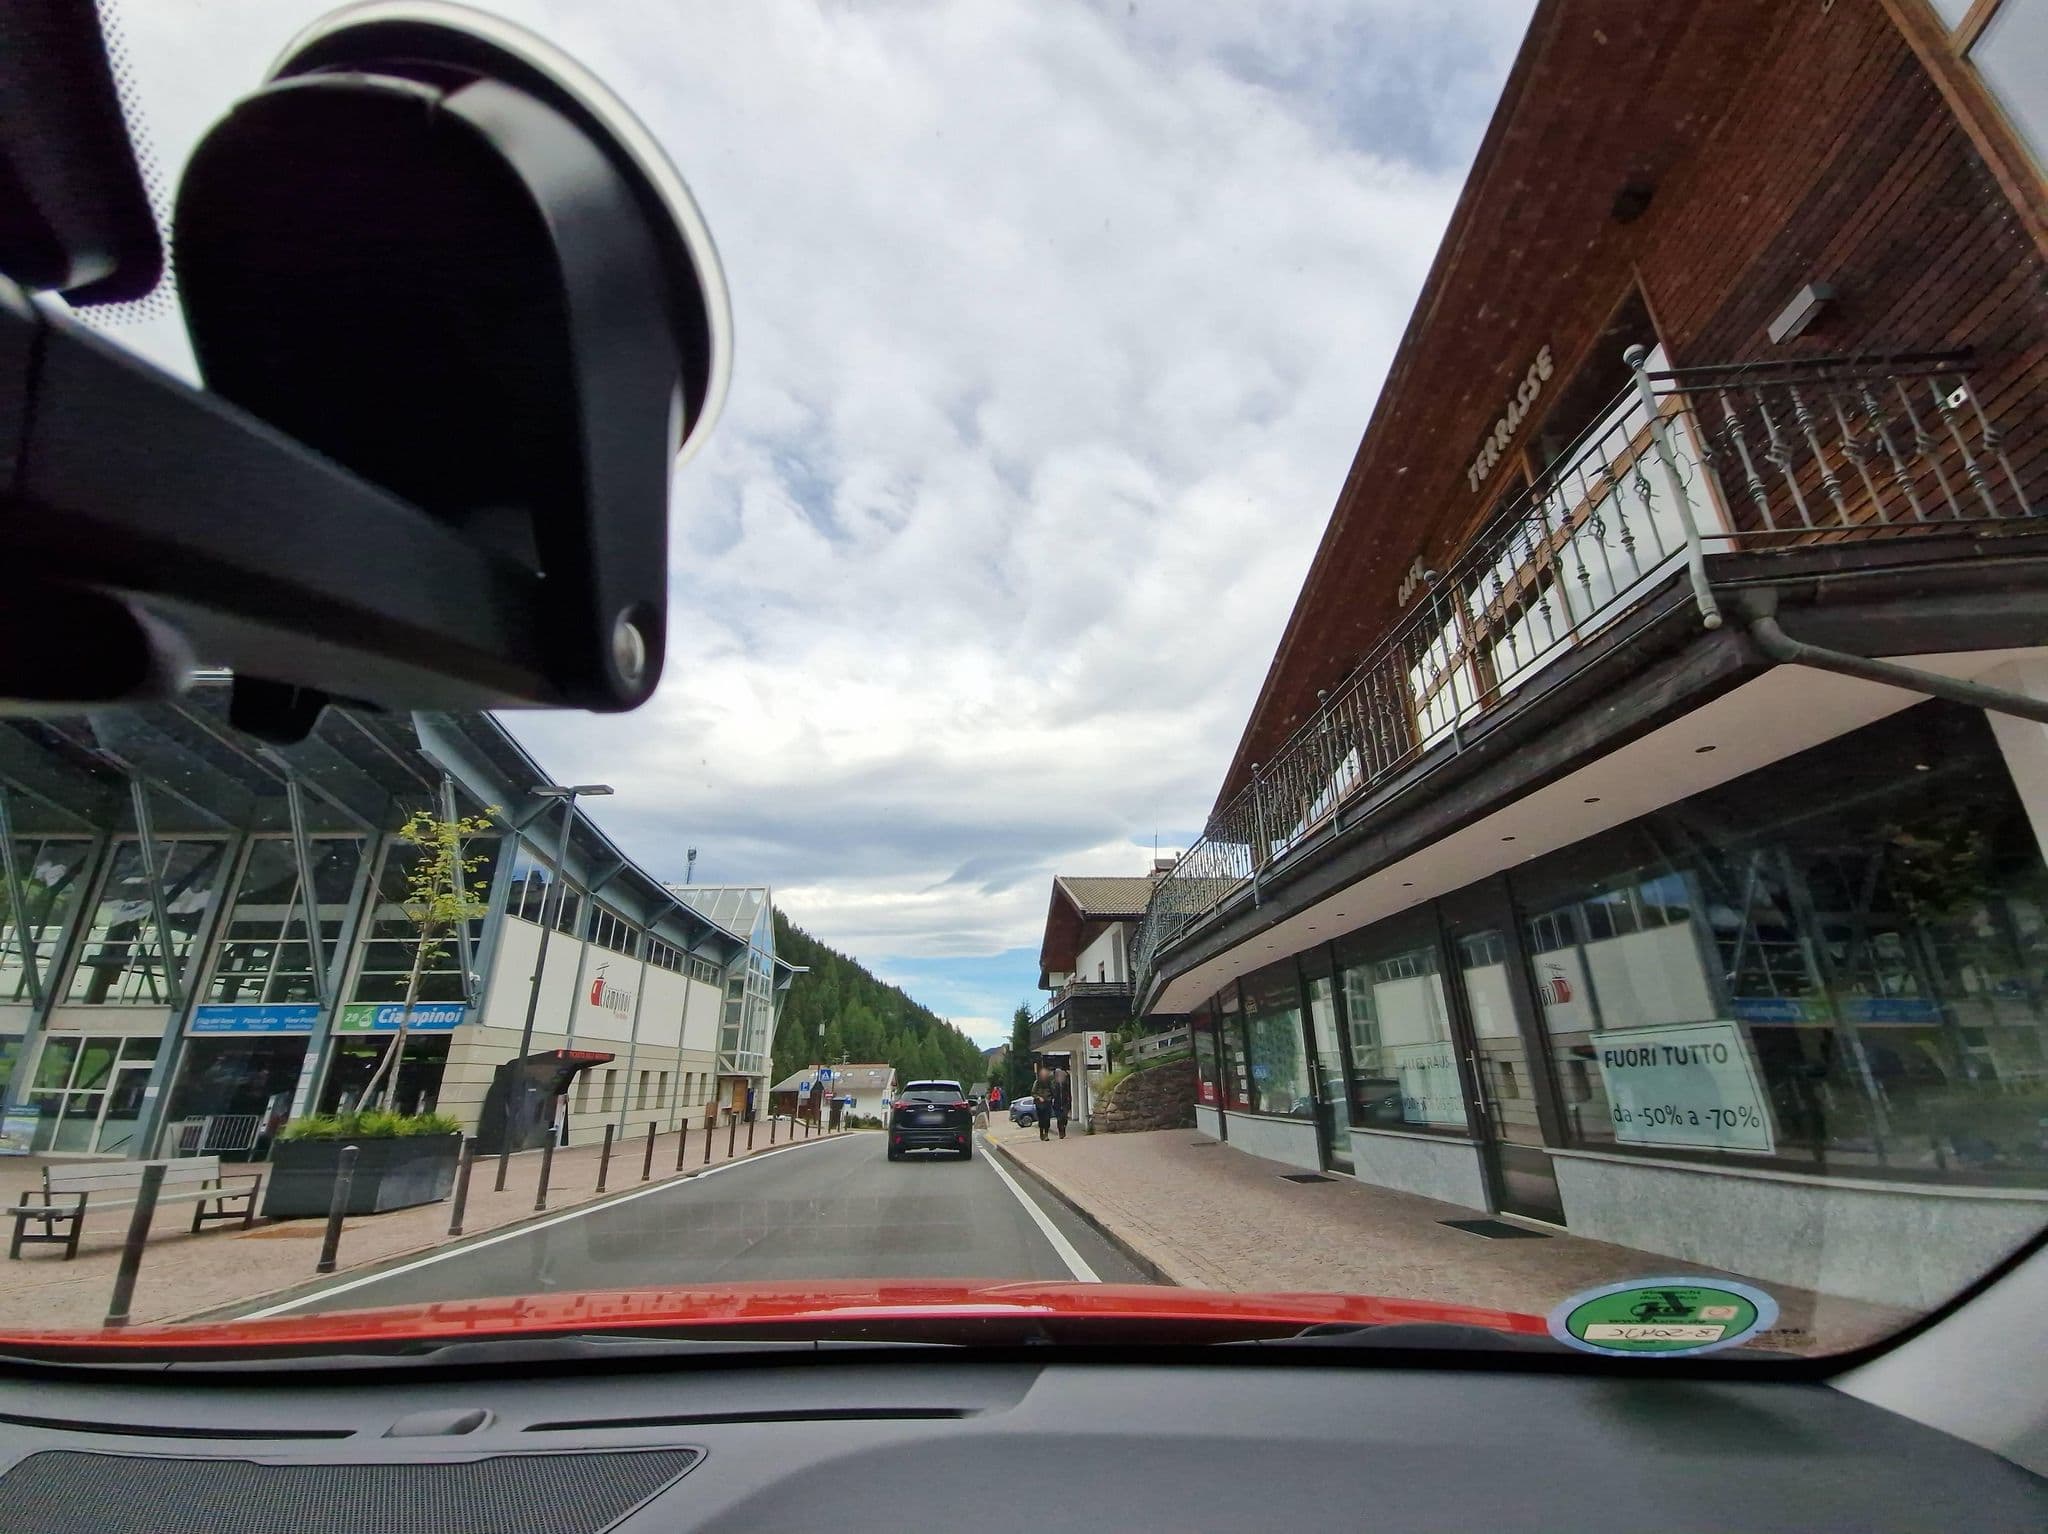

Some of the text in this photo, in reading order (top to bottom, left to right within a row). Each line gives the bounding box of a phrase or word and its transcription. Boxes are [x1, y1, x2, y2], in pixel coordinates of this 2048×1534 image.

[1467, 344, 1554, 493] TERRASSE
[1605, 1043, 1728, 1068] FUORI TUTTO
[1613, 1103, 1760, 1130] da -50% a -70%
